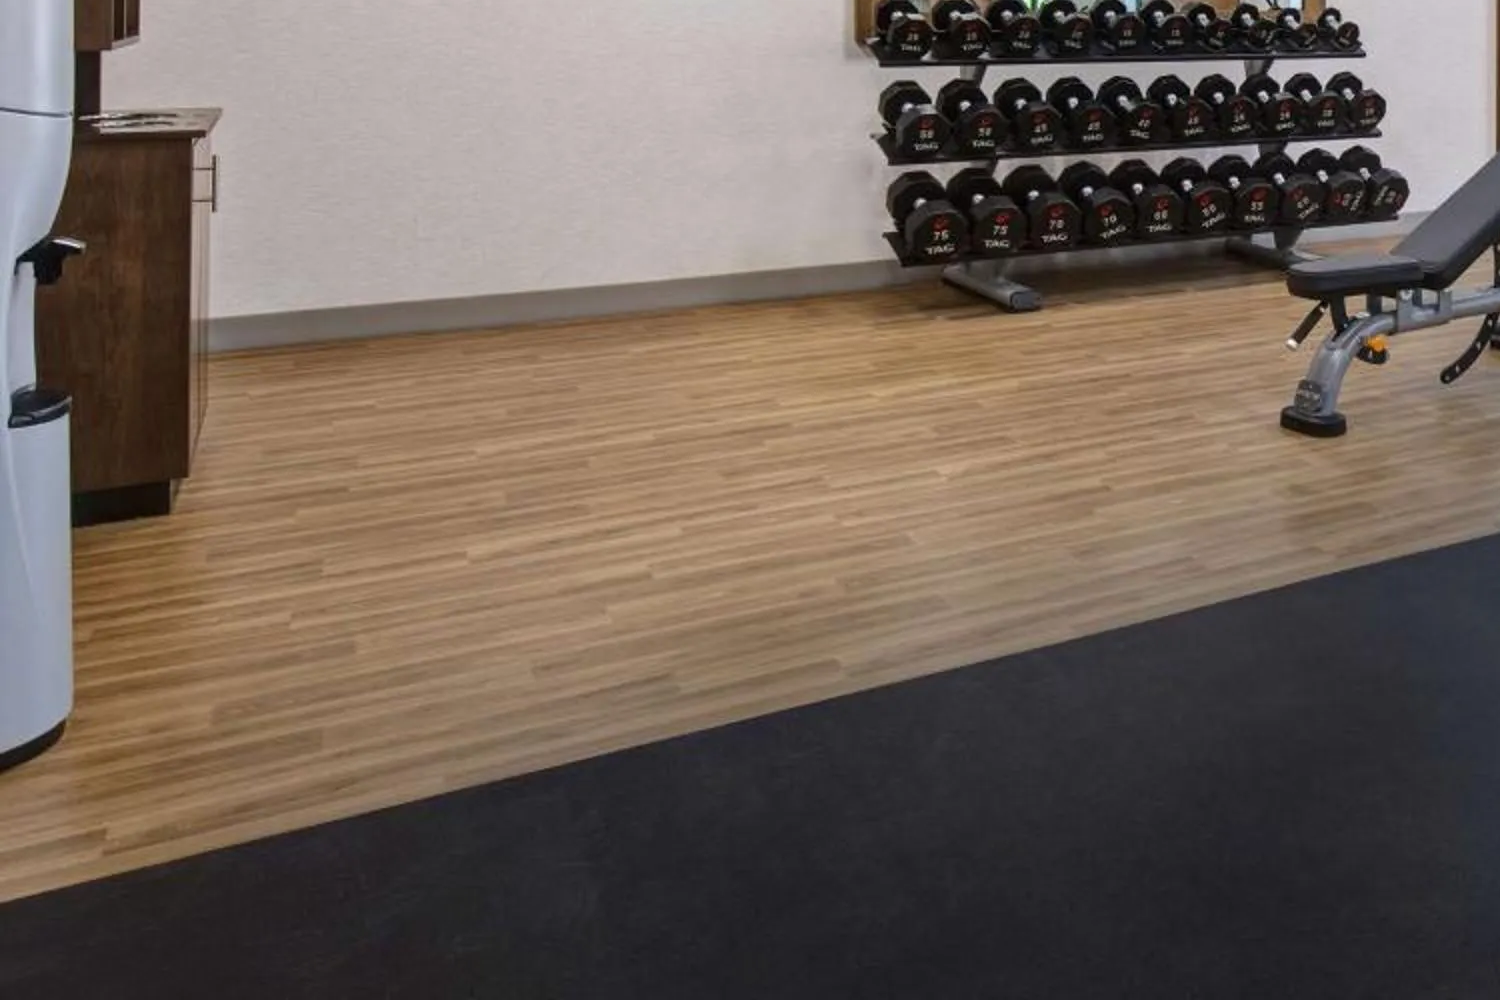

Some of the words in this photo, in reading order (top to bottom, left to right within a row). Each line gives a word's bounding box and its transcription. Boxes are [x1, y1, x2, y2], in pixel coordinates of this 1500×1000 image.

[1200, 211, 1227, 230] TAG
[1099, 224, 1127, 239] TAG
[1145, 222, 1173, 233] TAG
[1040, 231, 1070, 243] TAG
[924, 242, 956, 255] TAG
[983, 239, 1010, 249] TAG
